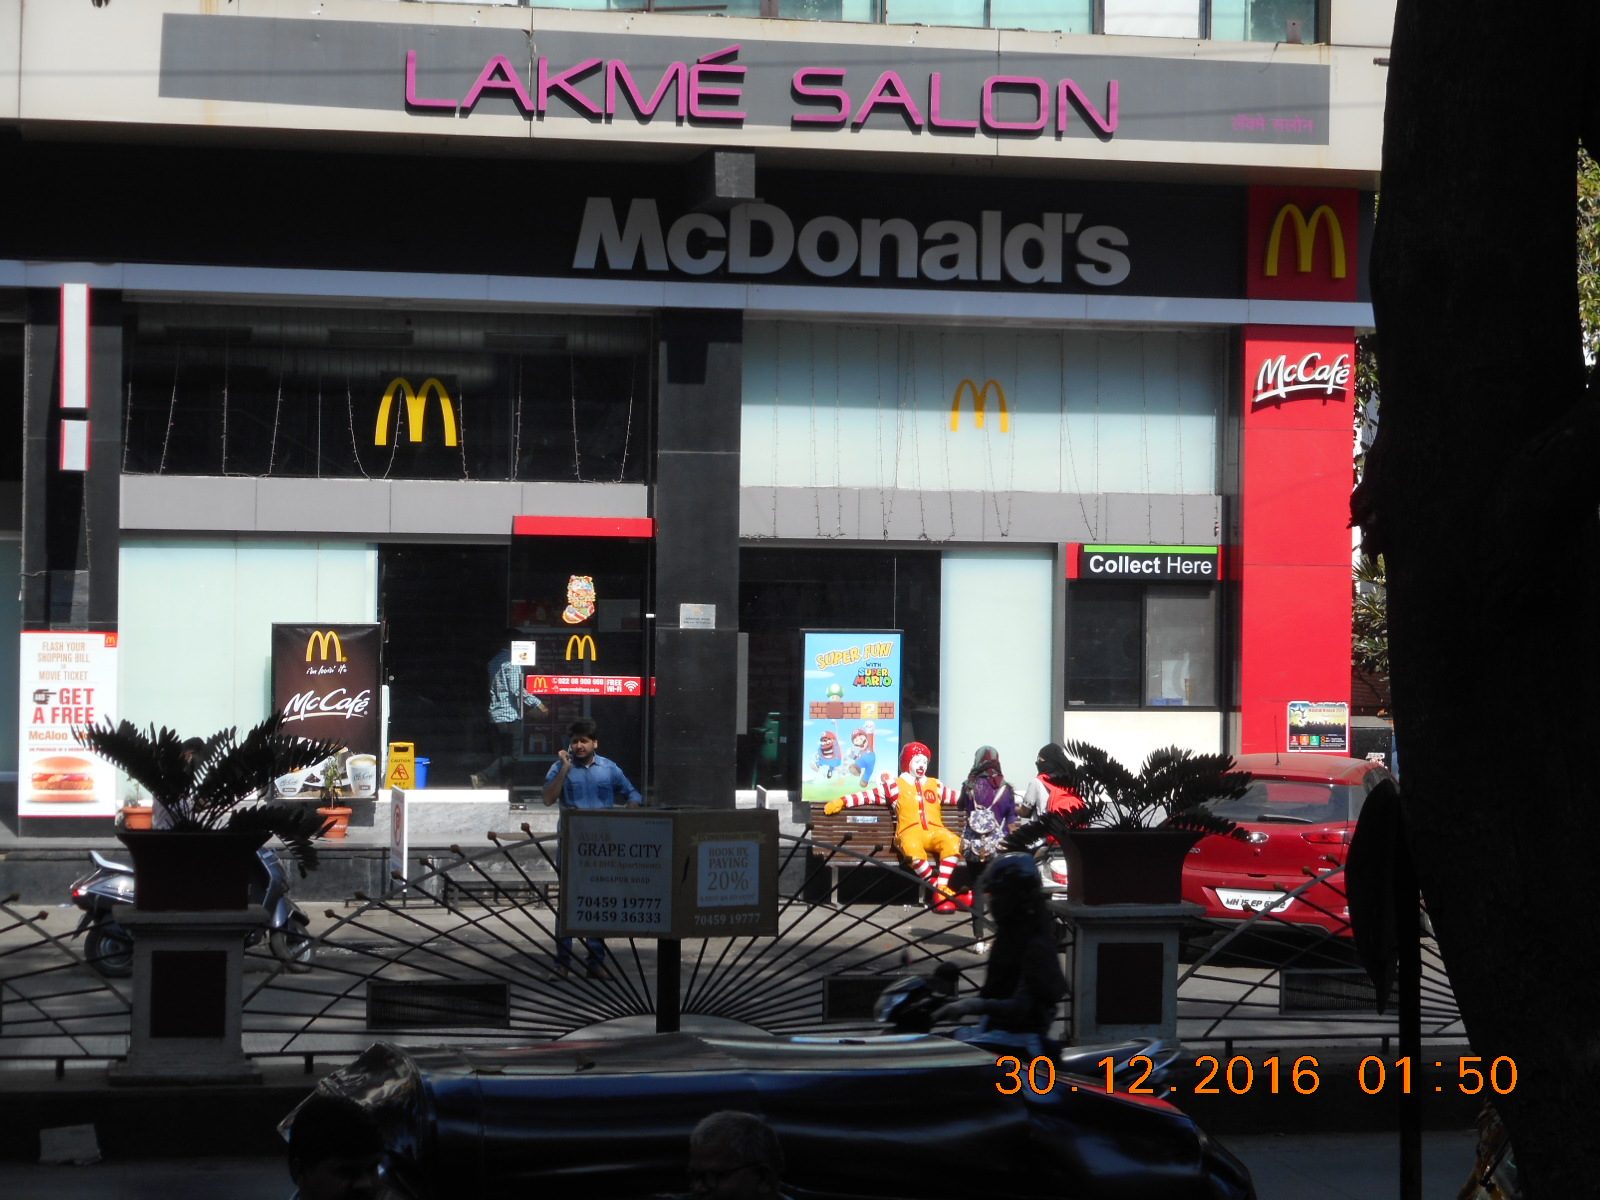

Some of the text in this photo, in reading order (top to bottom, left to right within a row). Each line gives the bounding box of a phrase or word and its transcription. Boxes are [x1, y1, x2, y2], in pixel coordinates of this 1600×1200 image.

[406, 45, 1119, 137] LAKMÉ SALON
[572, 194, 1132, 287] McDonald's
[1255, 352, 1350, 402] McCafé
[1089, 554, 1213, 575] Collect Here
[42, 641, 86, 652] FLASH YOUR
[37, 652, 91, 664] SHOPPING BILL
[816, 640, 894, 671] SUPER FUN
[39, 670, 89, 681] MOVIE TICKET
[857, 667, 890, 678] SUPER
[853, 675, 893, 688] MARIO
[59, 687, 95, 705] GET
[282, 687, 371, 723] McCafé
[32, 706, 96, 724] A FREE
[28, 730, 68, 741] McAloo
[577, 841, 662, 859] GRAPE CITY
[708, 847, 735, 857] BOOK
[708, 857, 749, 869] PAYING
[707, 870, 750, 891] 20%
[576, 896, 662, 909] 70459 19777
[576, 910, 661, 924] 70459 36333
[694, 912, 761, 926] 70459 19777
